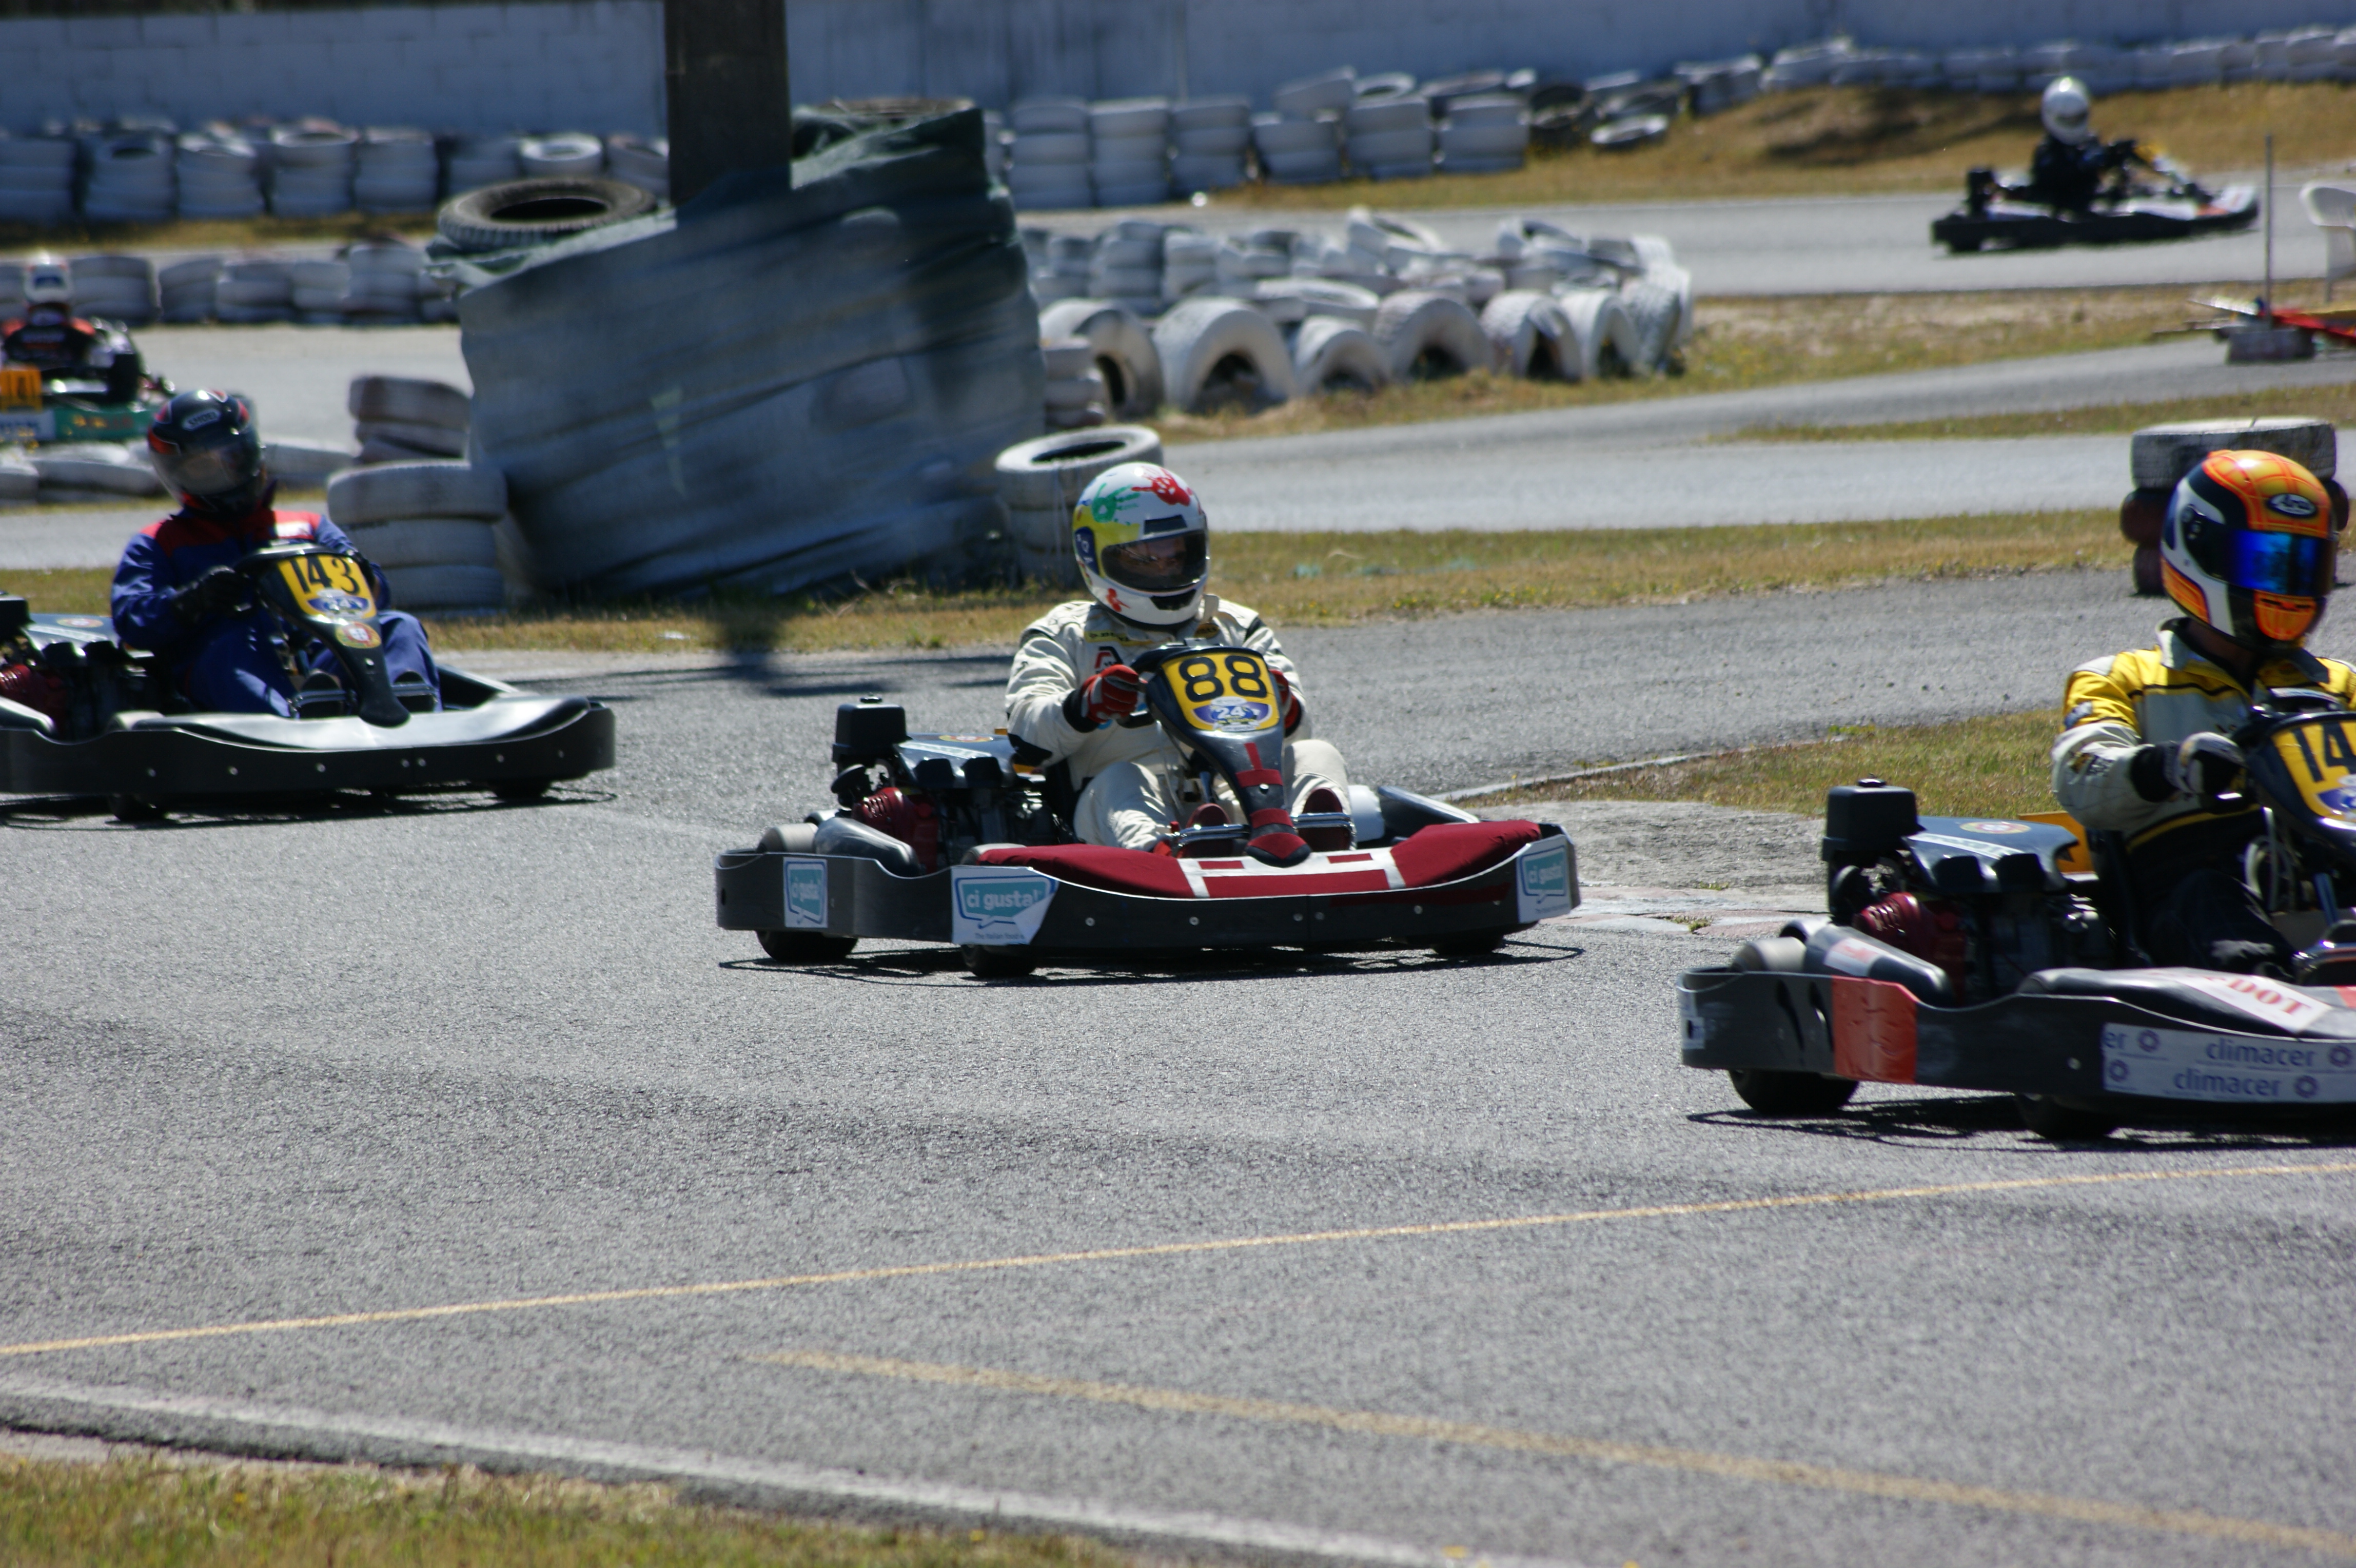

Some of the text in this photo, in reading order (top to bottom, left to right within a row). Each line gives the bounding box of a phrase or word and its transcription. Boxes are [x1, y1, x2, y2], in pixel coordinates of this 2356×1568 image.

[290, 556, 360, 594] 143
[1179, 655, 1267, 702] 88
[1217, 707, 1246, 719] 24
[966, 889, 979, 908] ci
[2206, 1037, 2316, 1067] climacer
[2173, 1067, 2282, 1097] climacer
